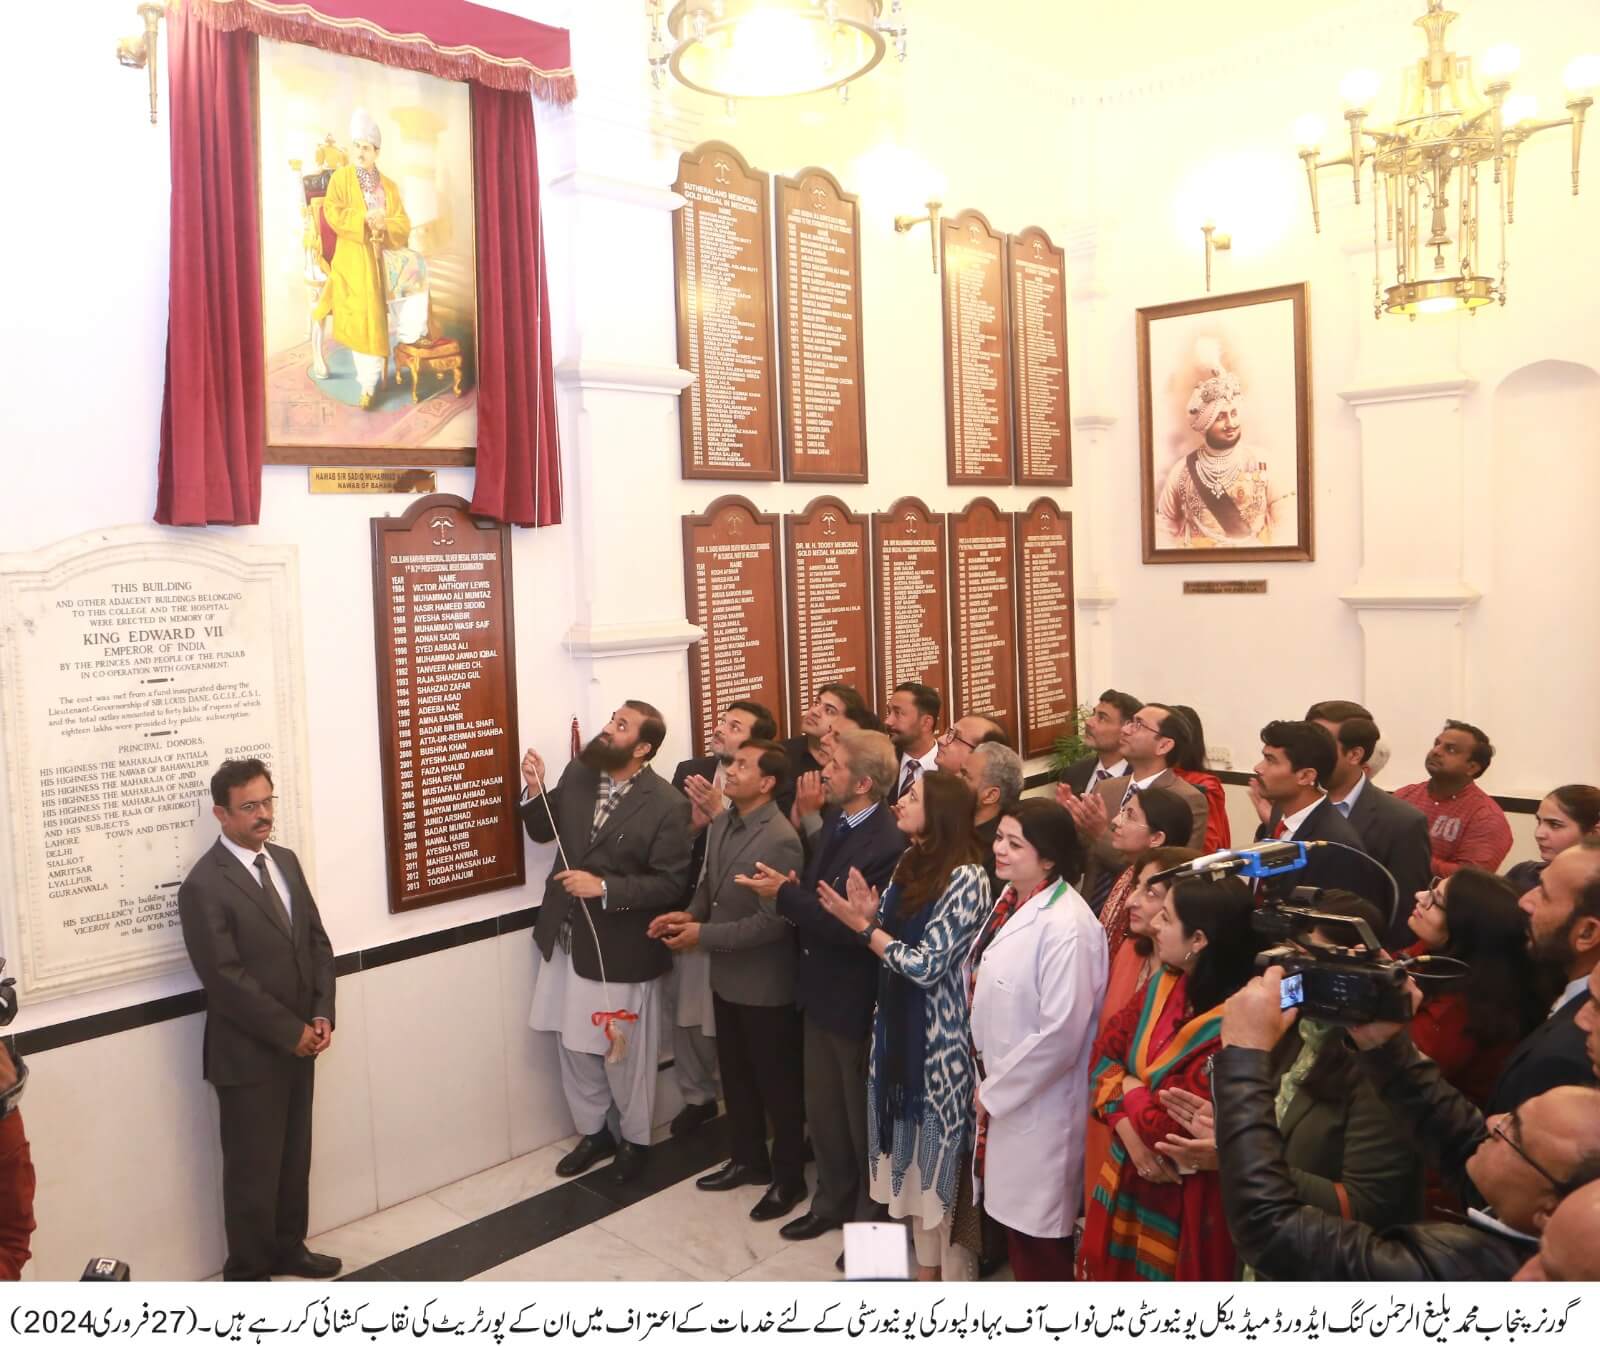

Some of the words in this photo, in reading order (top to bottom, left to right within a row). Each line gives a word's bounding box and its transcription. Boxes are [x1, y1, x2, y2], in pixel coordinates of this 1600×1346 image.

[315, 472, 336, 480] NAWAB
[392, 576, 404, 585] YEAR
[439, 574, 456, 582] NAME
[112, 583, 138, 594] THIS
[143, 580, 192, 593] BUILDING
[413, 584, 437, 592] VICTOR
[438, 582, 468, 590] ANTHONY
[77, 599, 105, 607] OTHER
[109, 597, 151, 606] ADJACENT
[156, 595, 196, 604] BUILDINGS
[198, 593, 242, 601] BELONGING
[413, 593, 452, 602] MUHAMMAD
[454, 592, 463, 600] ALI
[465, 590, 491, 599] MUMTAZ
[72, 610, 84, 618] TO
[88, 609, 106, 617] THIS
[109, 607, 146, 616] COLLEGE
[150, 606, 167, 614] AND
[191, 603, 228, 611] HOSPITAL
[90, 619, 112, 627] WERE
[117, 617, 155, 626] ERECTED
[170, 614, 202, 623] MEMORY
[83, 632, 120, 646] KING
[129, 627, 195, 643] EDWARD
[204, 626, 223, 638] VII
[104, 645, 153, 657] EMPEROR
[159, 644, 171, 653] OF
[178, 641, 205, 652] INDIA
[60, 663, 71, 671] BY
[75, 662, 92, 670] THE
[96, 659, 130, 668] PRINCES
[134, 657, 151, 666] AND
[154, 655, 182, 664] PEOPLE
[185, 654, 194, 662] OF
[199, 653, 213, 661] THE
[217, 650, 246, 660] PUNJAB
[416, 653, 454, 664] MUHAMMAD
[456, 651, 477, 660] JAWAD
[81, 672, 90, 680] IN
[153, 666, 174, 674] WITH
[417, 676, 434, 684] RAJA
[436, 672, 466, 682] SHAHZAD
[468, 671, 480, 679] GUL
[417, 684, 448, 694] SHAHZAD
[450, 682, 470, 691] ZAFAR
[418, 695, 442, 705] HAIDER
[444, 693, 461, 702] ASAD
[420, 745, 447, 755] BUSHRA
[449, 742, 467, 752] KHAN
[40, 768, 54, 777] HIS
[56, 763, 97, 776] HIGHNESS
[101, 761, 116, 770] THE
[119, 755, 163, 768] MAHARAJA
[164, 754, 175, 763] OF
[177, 750, 208, 761] PATIALA
[421, 755, 447, 766] AYESHA
[448, 751, 470, 762] JAVAID
[471, 748, 493, 758] AKRAM
[40, 778, 54, 787] HIS
[57, 772, 98, 785] HIGHNESS
[101, 770, 116, 780] THE
[120, 766, 146, 777] NAWAB
[148, 765, 157, 774] OF
[160, 759, 209, 772] BAHAWALPUR
[423, 784, 452, 796] MUSTAFA
[454, 780, 480, 791] MUMTAZ
[482, 776, 503, 786] HASAN
[423, 793, 461, 807] MUHAMMAD
[463, 789, 485, 800] AHMAD
[43, 818, 58, 828] HIS
[60, 813, 101, 826] HIGHNESS
[104, 810, 120, 820] THE
[122, 807, 142, 818] RAJA
[144, 806, 154, 815] OF
[158, 800, 197, 813] FARIDKOT
[45, 828, 62, 838] AND
[66, 826, 81, 835] HIS
[86, 819, 129, 833] SUBJECTS
[105, 827, 133, 839] TOWN
[136, 825, 154, 835] AND
[156, 819, 194, 832] DISTRICT
[45, 836, 80, 848] LAHORE
[46, 848, 73, 858] DELHI
[427, 854, 453, 866] MAHEEN
[455, 849, 478, 861] ANWAR
[47, 856, 85, 868] SIALKOT
[48, 865, 93, 879] AMRITSAR
[48, 875, 92, 889] LYALLPUR
